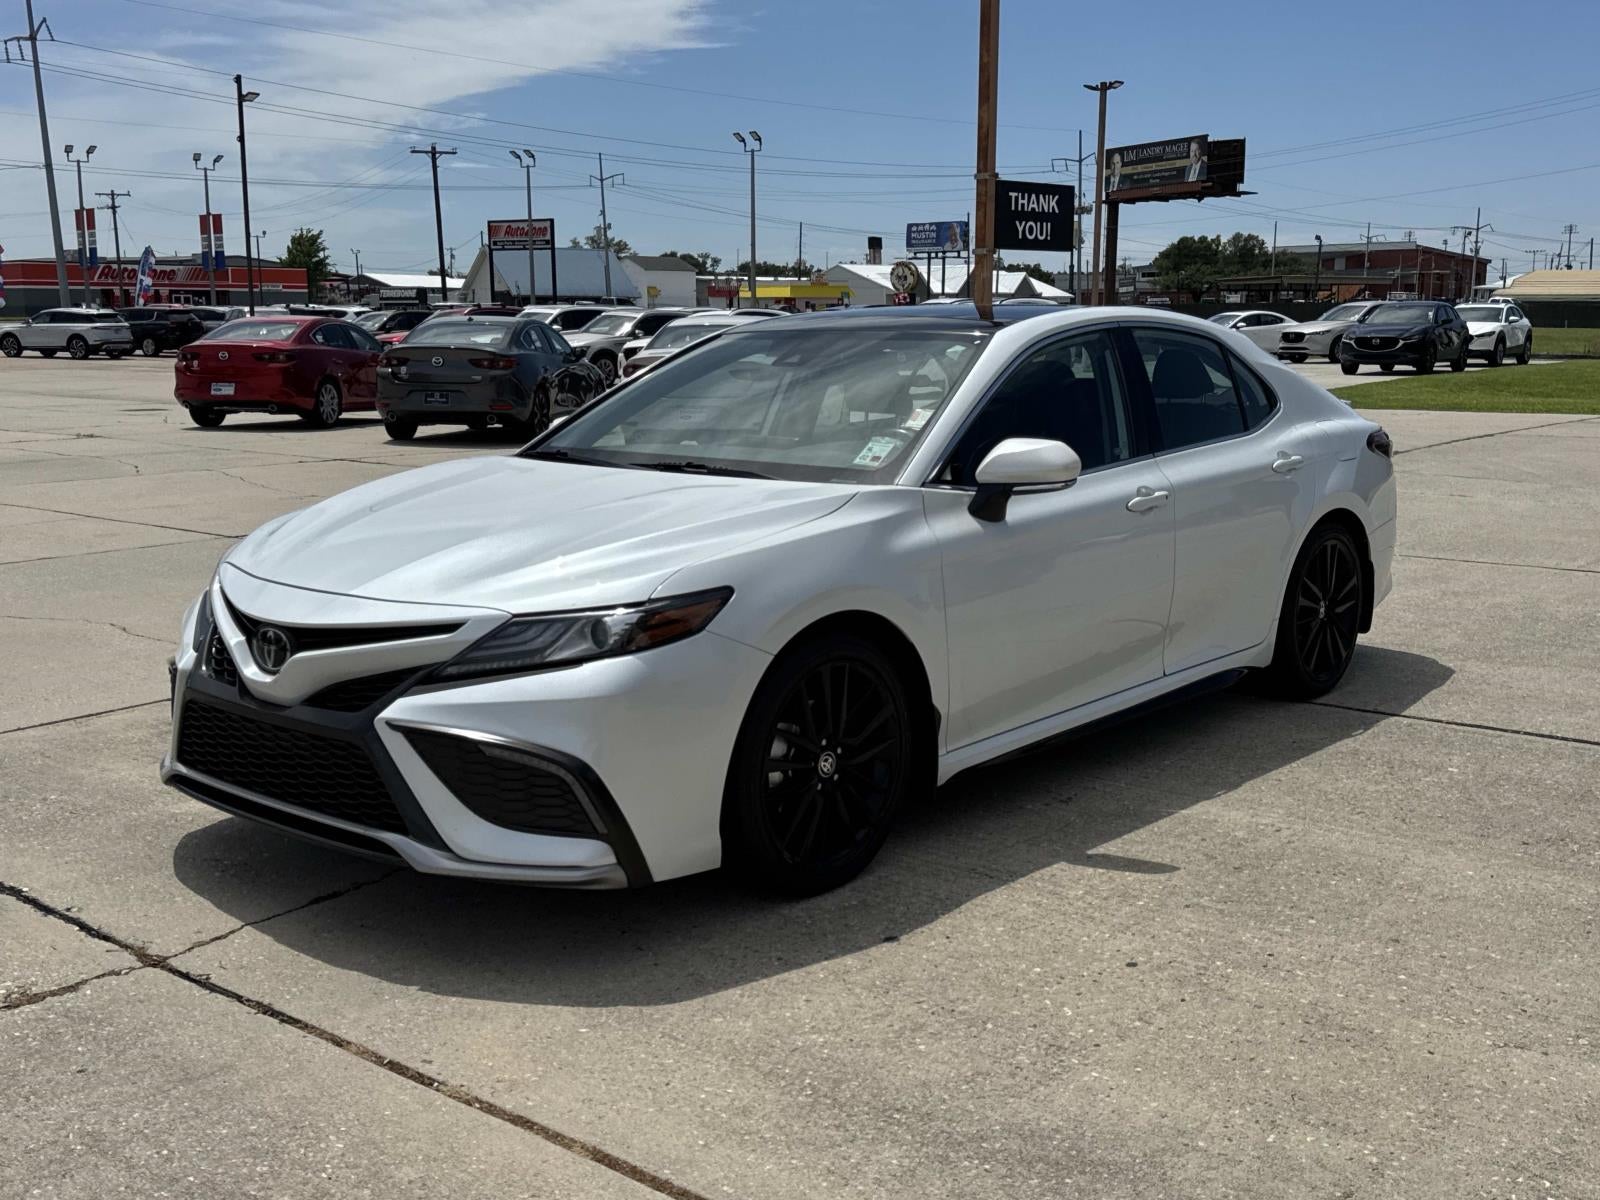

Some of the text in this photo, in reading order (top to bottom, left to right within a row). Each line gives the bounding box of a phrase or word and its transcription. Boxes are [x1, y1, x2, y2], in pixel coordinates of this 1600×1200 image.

[1139, 146, 1164, 157] LANDRY
[1165, 142, 1188, 153] MAGEE
[1008, 192, 1059, 213] THANK
[1015, 220, 1051, 240] YOU!
[97, 265, 176, 280] Autoone
